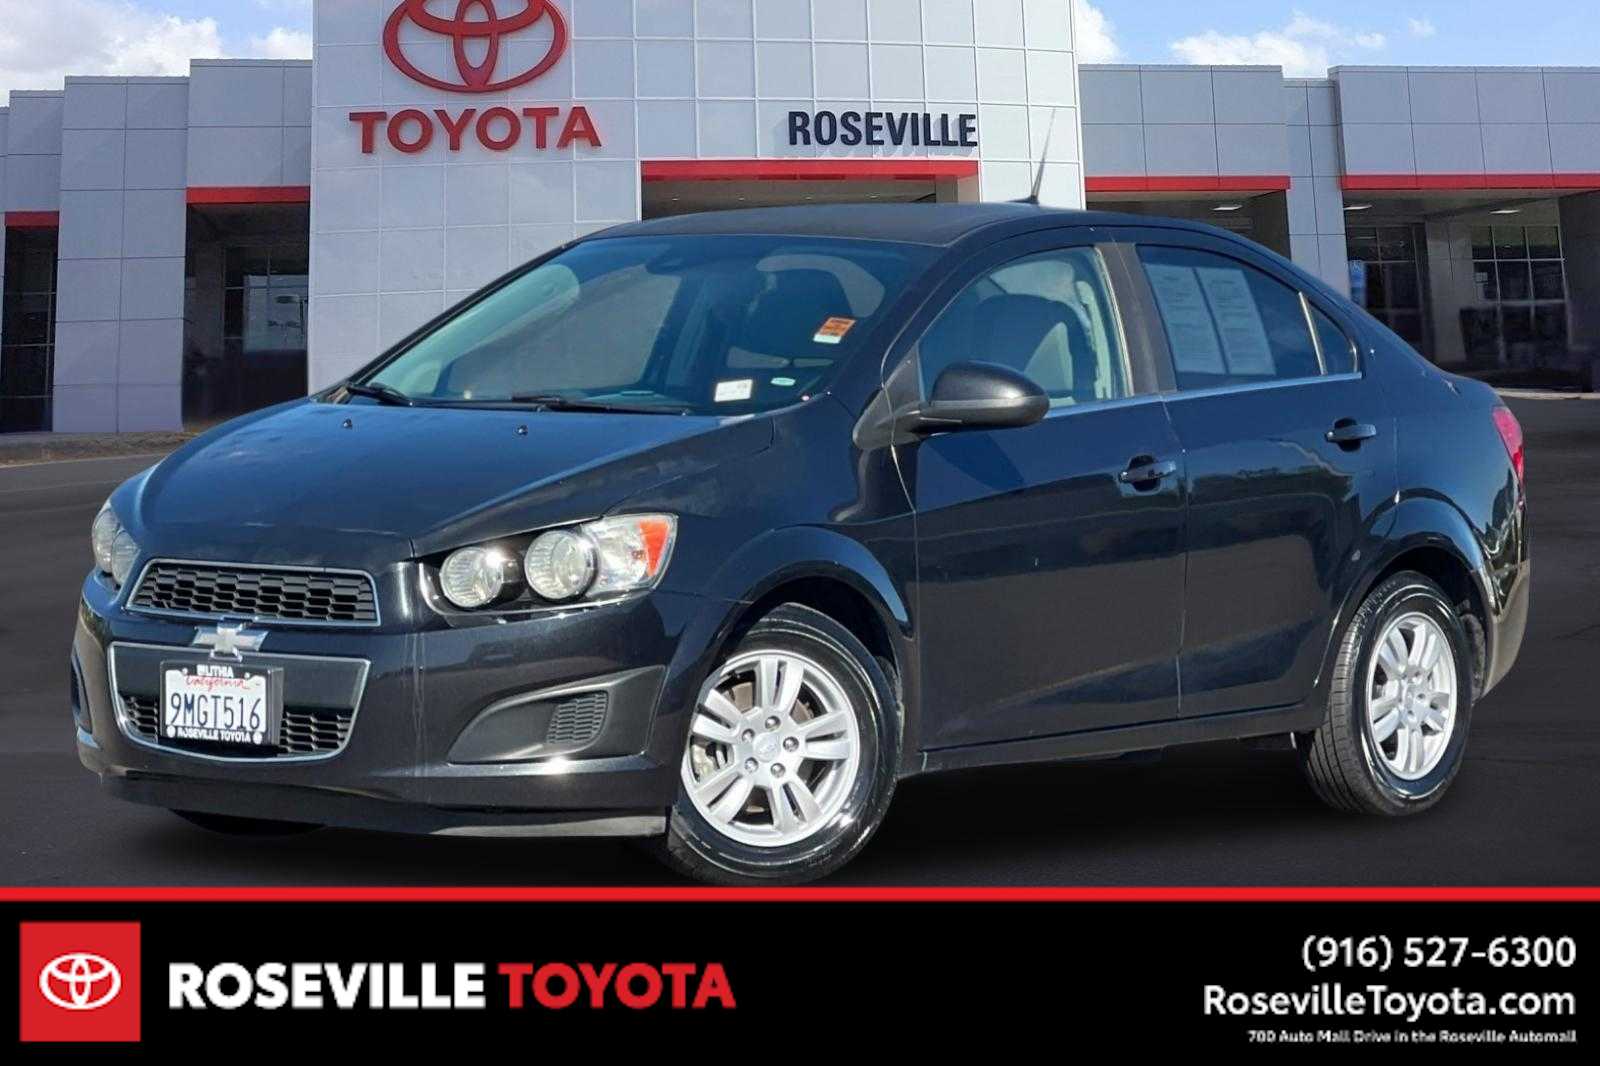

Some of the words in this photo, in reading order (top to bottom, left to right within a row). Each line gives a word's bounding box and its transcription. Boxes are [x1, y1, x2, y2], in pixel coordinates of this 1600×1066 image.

[349, 106, 603, 153] TOYOTA
[788, 111, 979, 147] ROSEVILLE
[170, 692, 262, 730] 9MGT516
[178, 727, 219, 740] ROSEVILLE
[220, 731, 251, 743] TOYOTA
